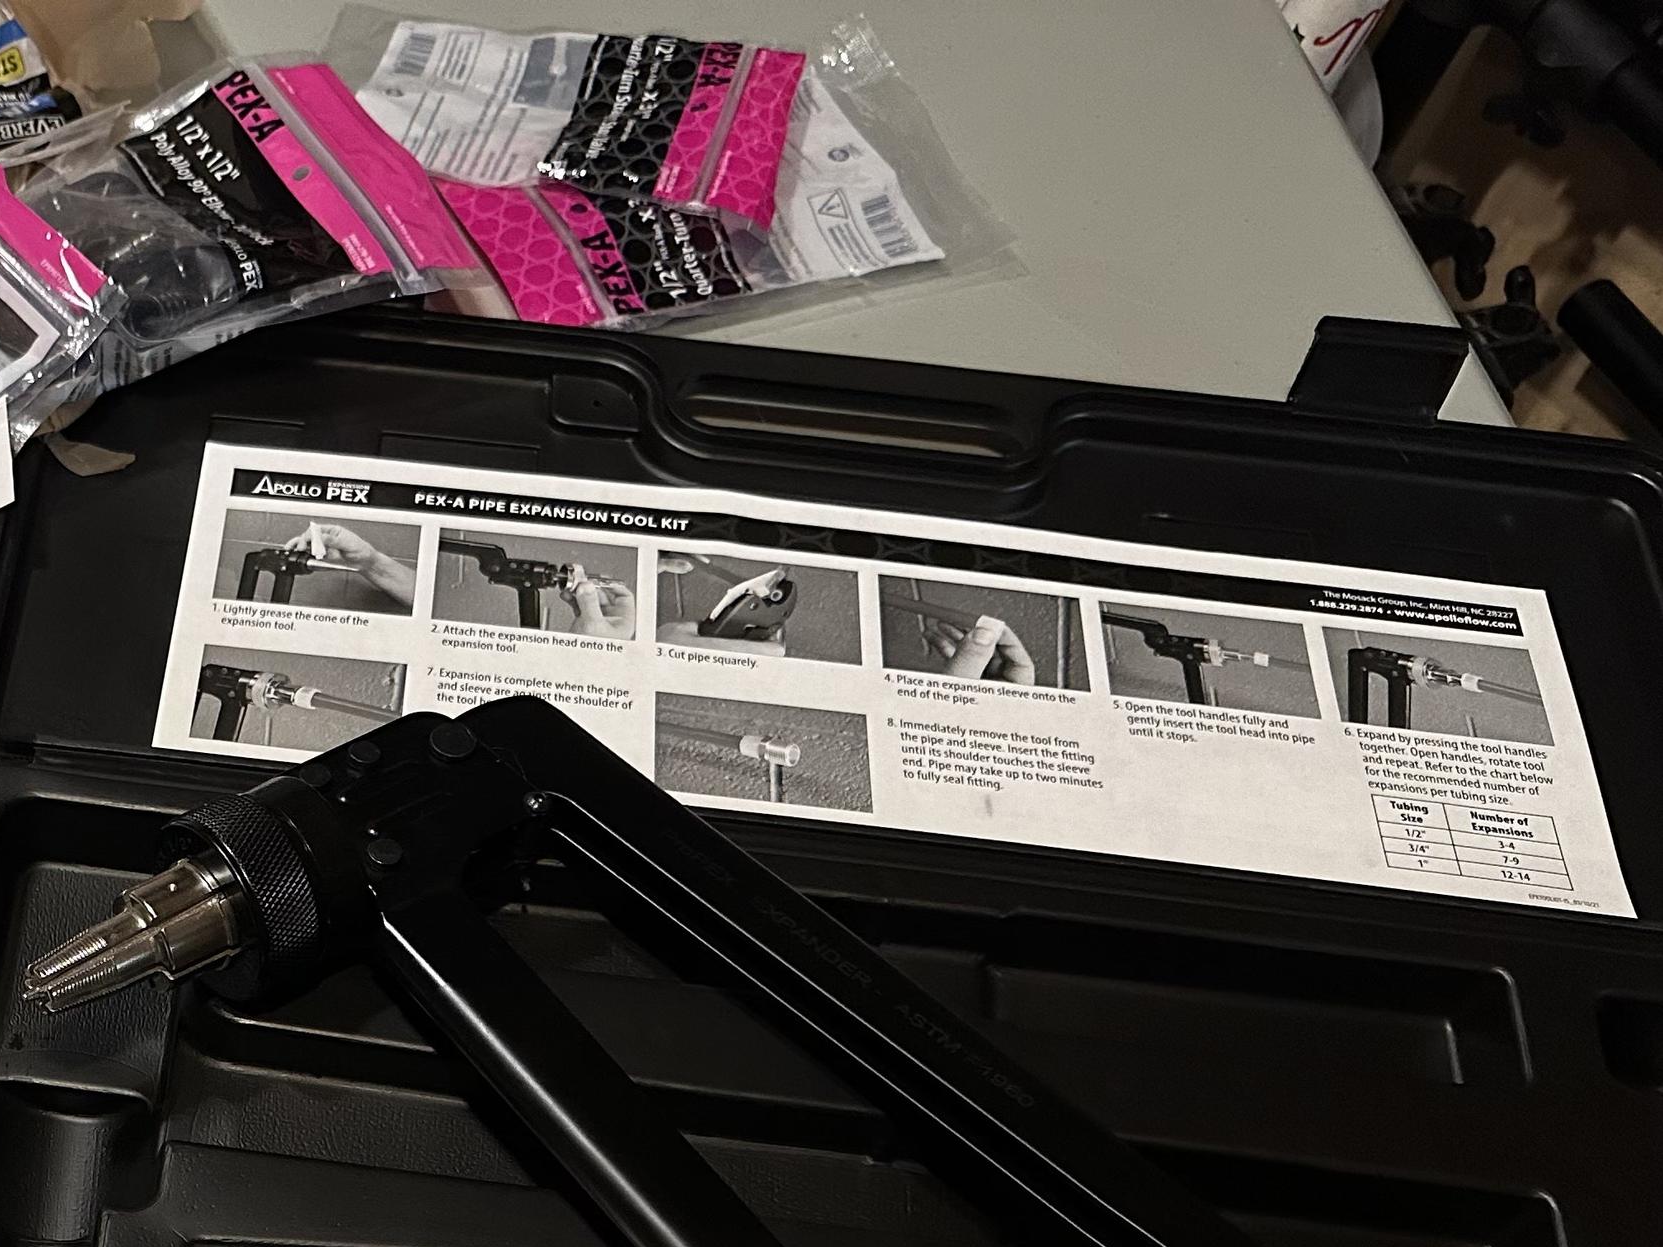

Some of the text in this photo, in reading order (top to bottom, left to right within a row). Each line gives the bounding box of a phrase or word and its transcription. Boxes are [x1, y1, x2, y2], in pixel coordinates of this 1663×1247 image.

[214, 70, 285, 143] PEX-A
[150, 131, 176, 160] Poly
[167, 149, 195, 182] Alloy
[176, 115, 210, 146] 1/2"
[206, 151, 242, 182] 1/2"
[669, 212, 714, 296] Quarter-Turn
[239, 261, 259, 291] PEX
[580, 231, 644, 314] PEX-A
[653, 262, 687, 298] 1/2"
[251, 474, 369, 504] APOLLO PEX
[414, 492, 689, 531] PEX-A PIPE EXPANSION TOOL KIT
[1323, 590, 1341, 599] The
[1430, 603, 1451, 612] Mint
[220, 617, 296, 631] expansion tool.
[223, 603, 258, 617] Lightly
[259, 608, 293, 619] grease
[294, 611, 312, 621] the
[313, 615, 338, 623] cone
[339, 615, 350, 624] of
[351, 616, 369, 627] the
[1394, 608, 1518, 630] www.apolloflow.com
[441, 637, 519, 653] expansion tool.
[443, 625, 476, 638] Attach
[478, 628, 496, 639] the
[498, 631, 550, 645] expansion
[552, 635, 578, 648] head
[580, 641, 604, 651] onto
[605, 642, 624, 653] the
[668, 648, 685, 660] Cut
[688, 652, 710, 663] pipe
[713, 656, 759, 669] squarely.
[897, 675, 925, 686] Place
[926, 679, 939, 688] an
[942, 680, 995, 695] expansion
[997, 687, 1030, 699] sleeve
[1031, 691, 1056, 702] onto
[1058, 694, 1076, 705] the
[897, 688, 979, 706] end of the pipe.
[1125, 702, 1153, 713] Open
[1156, 705, 1173, 716] the
[1175, 708, 1197, 718] tool
[1199, 709, 1241, 723] handles
[1243, 714, 1266, 728] fully
[1268, 719, 1289, 729] and
[1127, 715, 1316, 745] gently insert the tool head into pipe
[1129, 726, 1198, 743] until it stops.
[1390, 800, 1429, 815] Tubing
[1400, 813, 1424, 824] Size
[1470, 811, 1529, 826] Number of
[1404, 828, 1426, 839] 1/2"
[1471, 823, 1534, 839] Expansions
[1408, 843, 1430, 853] 3/4"
[1498, 840, 1516, 850] 3-4
[1418, 858, 1430, 868] 1"
[1502, 855, 1520, 866] 7-9
[1501, 870, 1531, 882] 12-14
